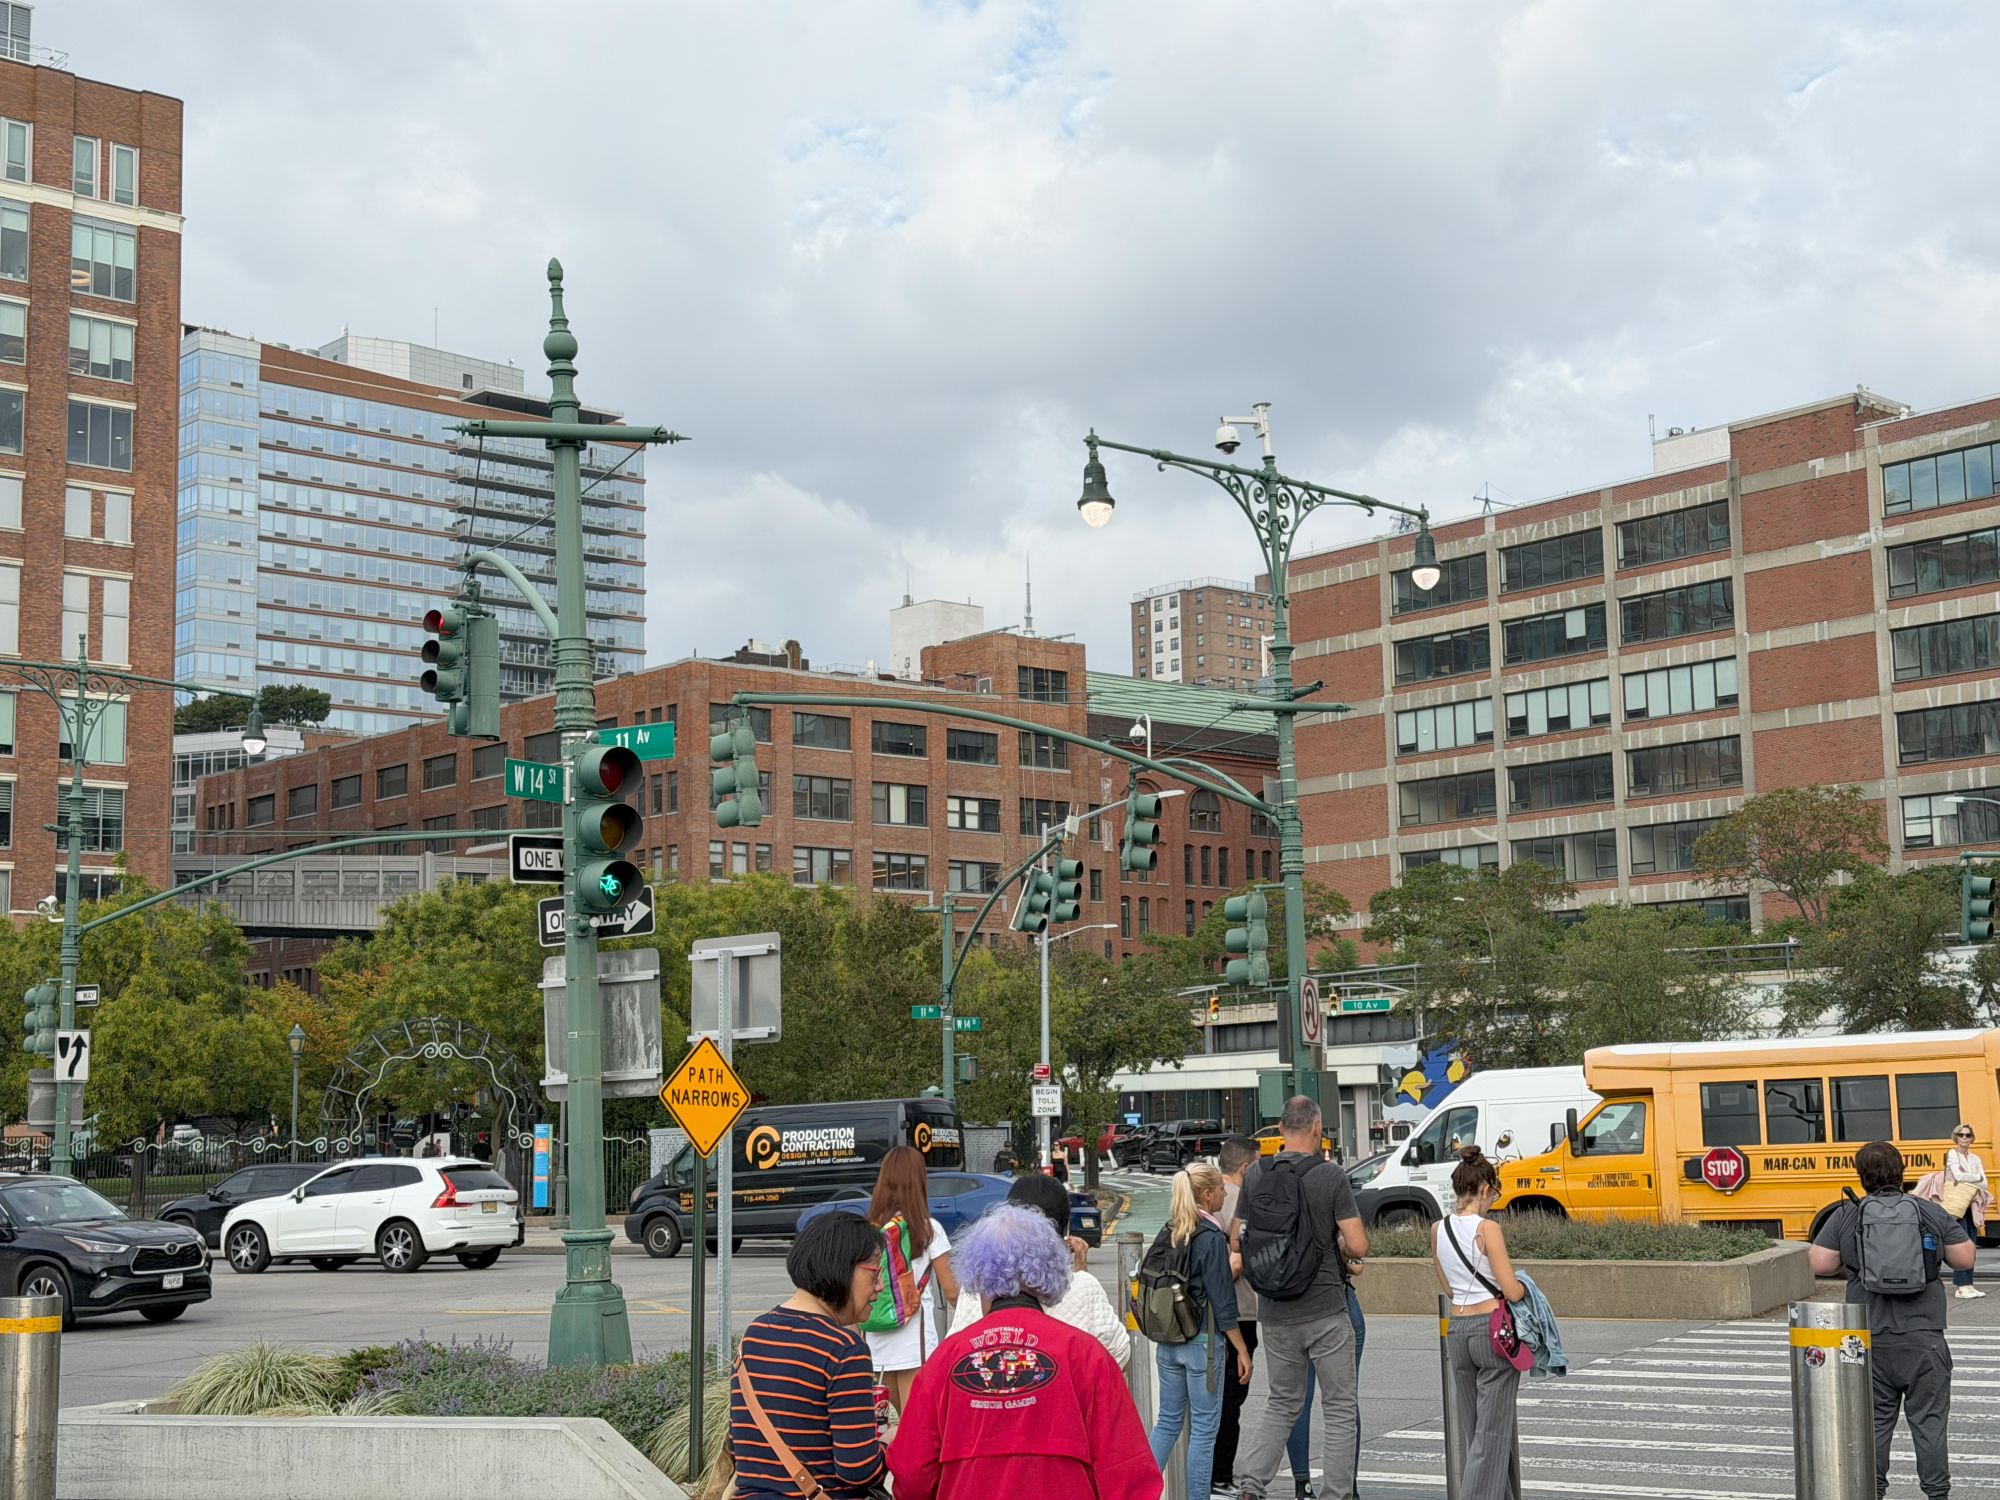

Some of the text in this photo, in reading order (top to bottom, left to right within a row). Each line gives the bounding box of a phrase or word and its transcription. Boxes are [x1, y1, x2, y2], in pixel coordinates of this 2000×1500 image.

[637, 729, 650, 744] Av
[514, 765, 557, 795] W 14 St
[525, 852, 553, 868] ONE
[920, 1007, 927, 1017] 11
[956, 1019, 962, 1029] W
[963, 1019, 971, 1030] 14
[688, 1067, 724, 1084] PATH
[671, 1089, 740, 1108] NARROWS
[1035, 1088, 1058, 1096] BEGIN
[783, 1127, 855, 1142] PRODUCTION
[931, 1128, 959, 1137] PRODUCTION
[781, 1139, 855, 1153] CONTRACTING
[1707, 1160, 1738, 1177] STOP
[1763, 1156, 1817, 1171] MAR-CAN
[1517, 1178, 1546, 1189] MW 72
[970, 1330, 1039, 1349] WORLD
